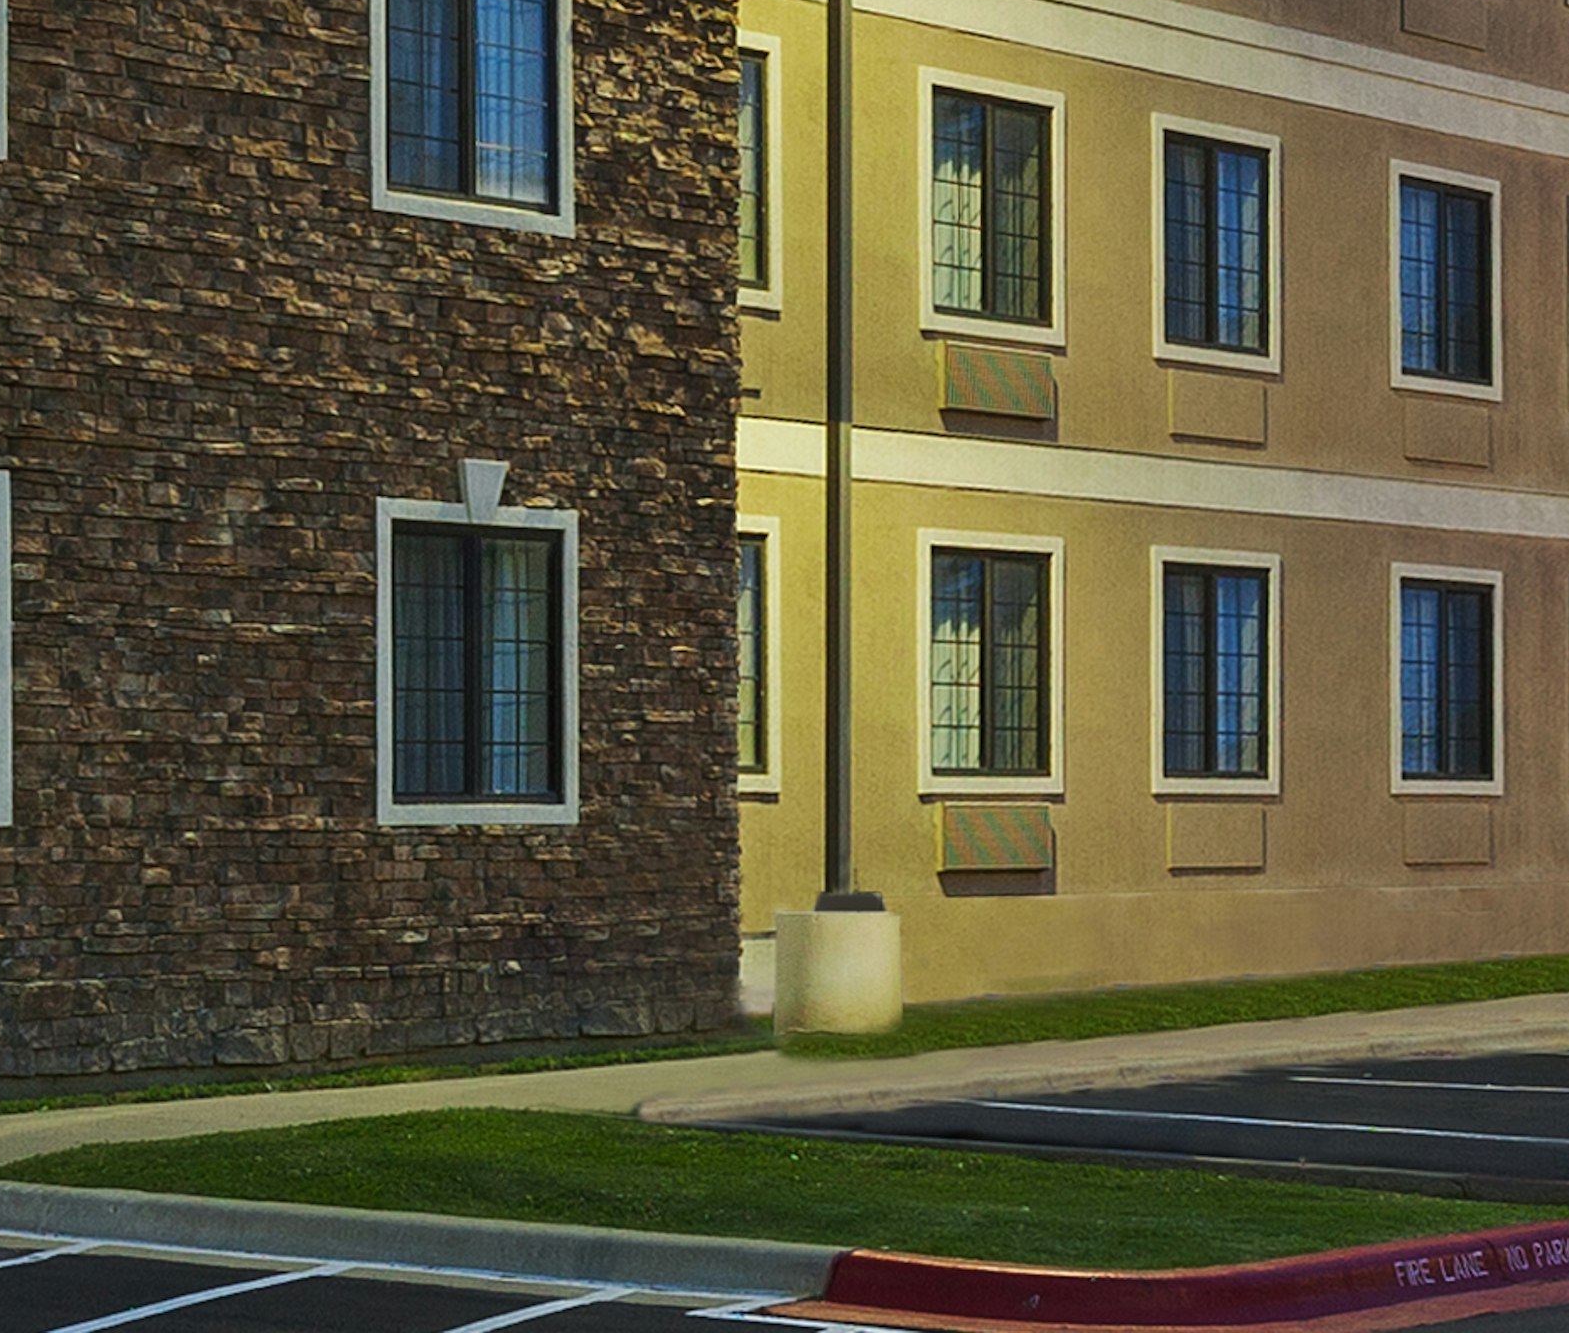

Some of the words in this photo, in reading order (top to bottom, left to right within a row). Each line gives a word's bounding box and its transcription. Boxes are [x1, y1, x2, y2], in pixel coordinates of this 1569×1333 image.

[1394, 1258, 1435, 1287] FIRE
[1439, 1251, 1489, 1282] LANE
[1504, 1245, 1530, 1272] NO
